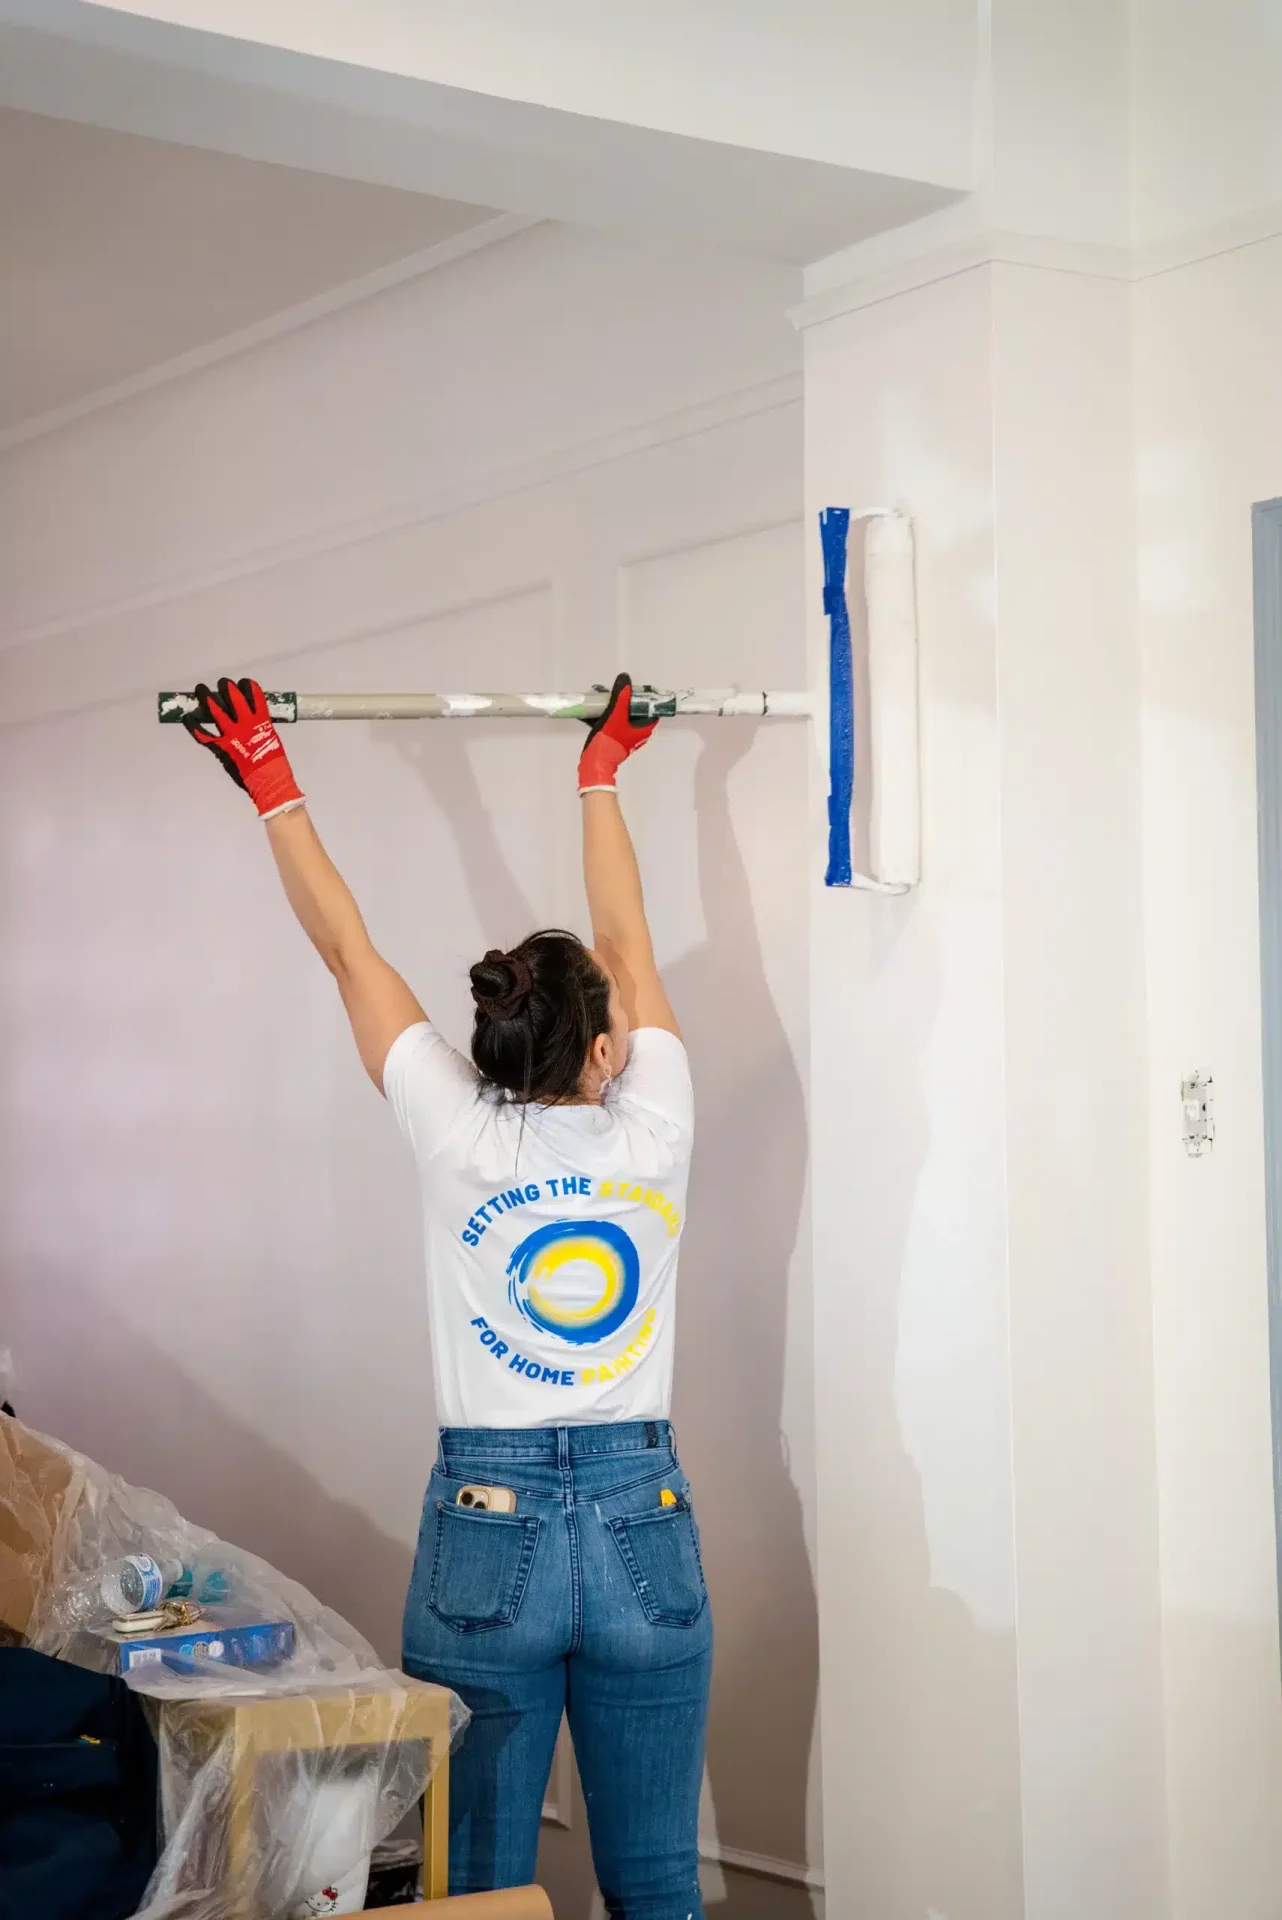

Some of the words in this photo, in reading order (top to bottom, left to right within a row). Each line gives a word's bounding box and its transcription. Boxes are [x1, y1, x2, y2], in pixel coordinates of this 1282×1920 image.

[462, 1183, 541, 1247] SETTING
[546, 1176, 592, 1198] THE
[470, 1316, 510, 1360] FOR
[508, 1353, 576, 1387] HOME
